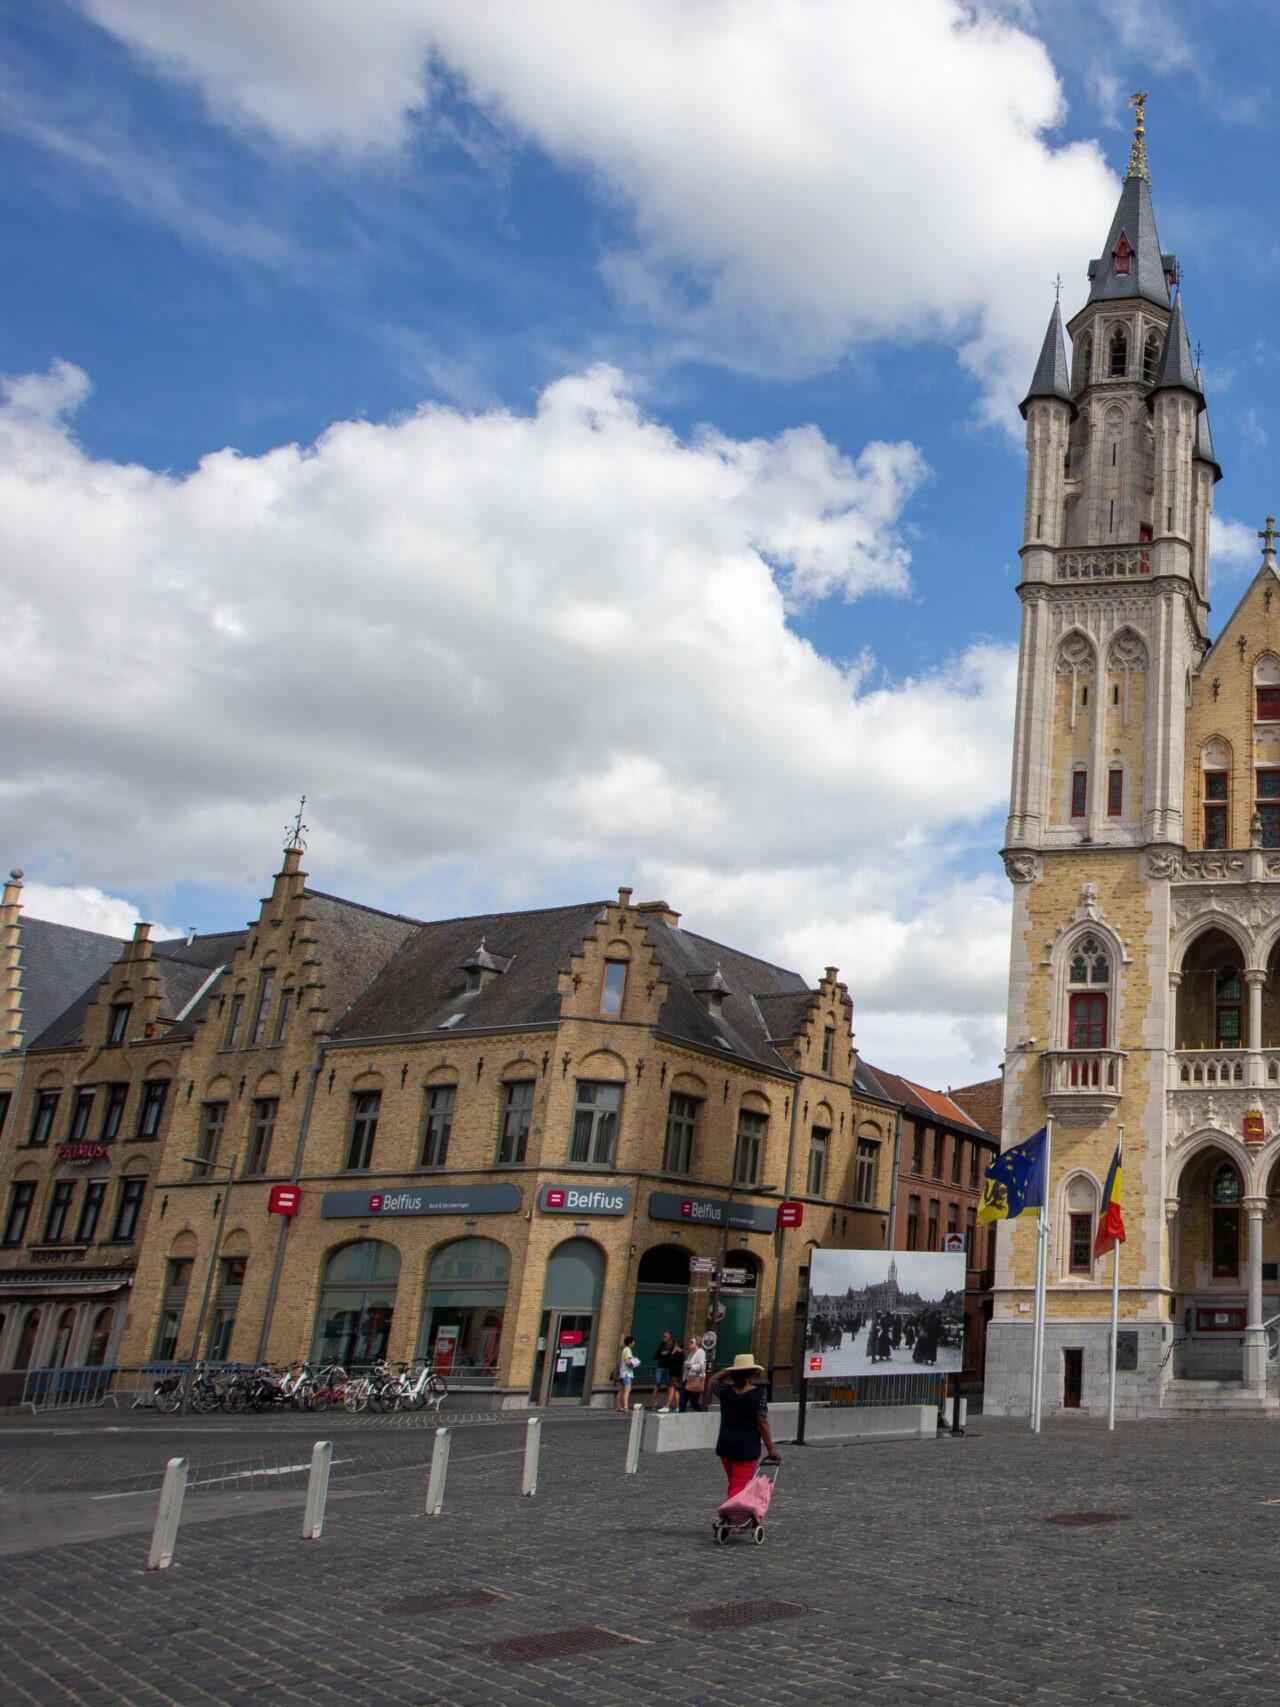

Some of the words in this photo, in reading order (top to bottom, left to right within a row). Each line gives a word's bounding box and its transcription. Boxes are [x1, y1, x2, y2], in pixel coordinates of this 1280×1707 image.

[56, 1144, 106, 1158] PRIMUS
[382, 1194, 422, 1210] Belfius
[567, 1191, 624, 1209] Belfius
[691, 1202, 722, 1220] Belfius
